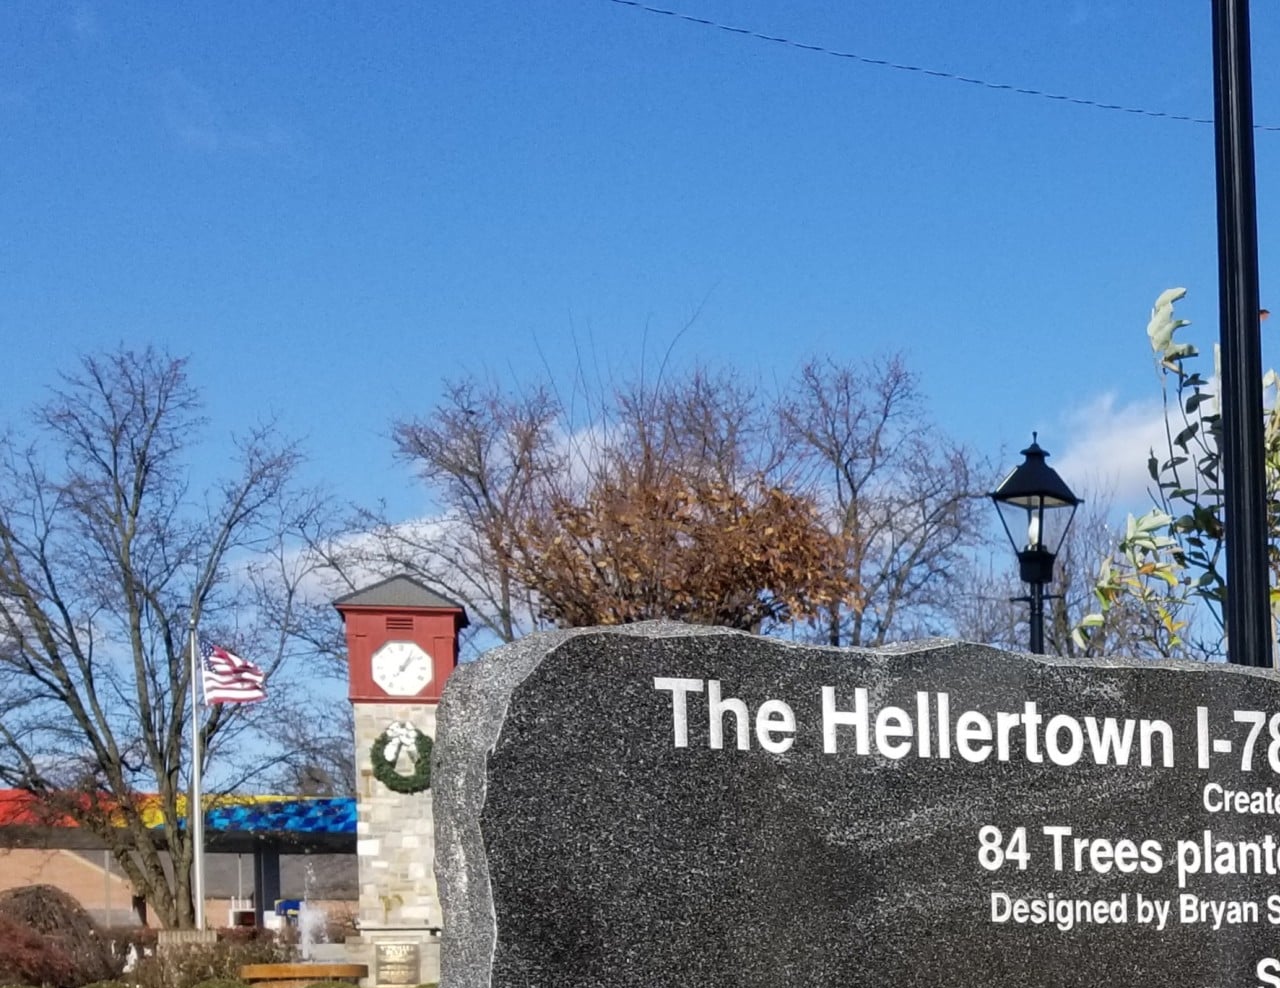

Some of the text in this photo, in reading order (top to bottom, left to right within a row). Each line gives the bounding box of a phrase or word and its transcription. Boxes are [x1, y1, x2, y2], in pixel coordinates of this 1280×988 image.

[654, 677, 796, 753] The
[822, 683, 1174, 768] Hellertown
[978, 825, 1030, 871] 84
[1043, 826, 1163, 873] Trees
[991, 892, 1127, 931] Designed
[1137, 893, 1170, 930] by
[1179, 894, 1258, 930] Bryan
